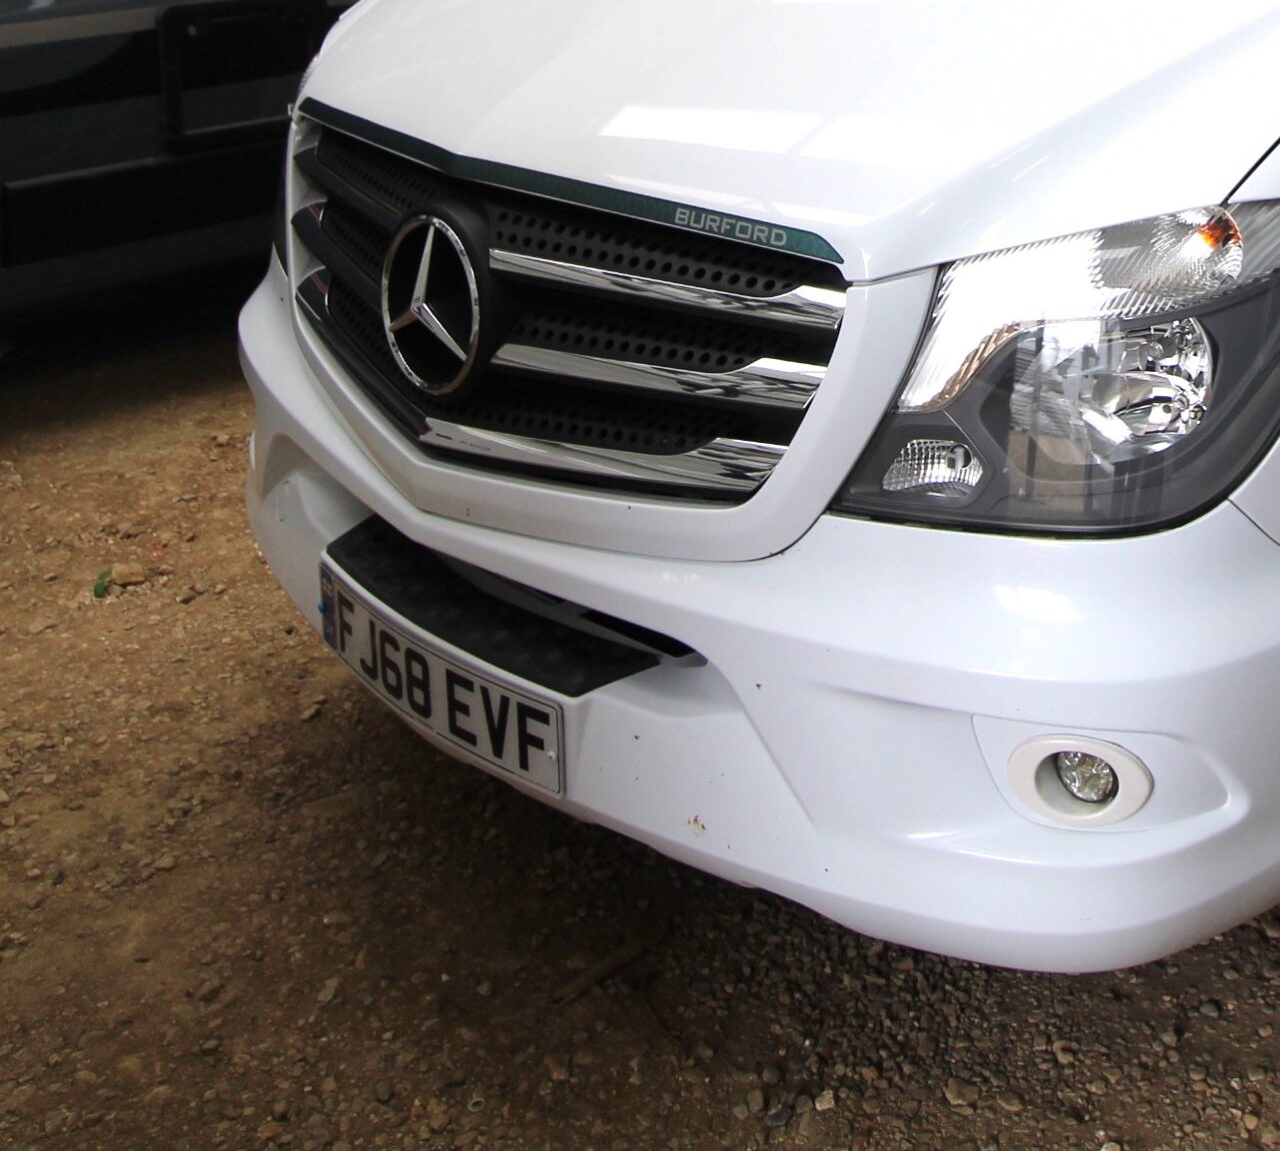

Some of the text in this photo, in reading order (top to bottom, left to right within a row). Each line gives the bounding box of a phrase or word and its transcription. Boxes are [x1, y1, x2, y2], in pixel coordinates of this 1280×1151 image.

[674, 207, 788, 246] BURFORD
[336, 590, 551, 772] FJ68 EVF
